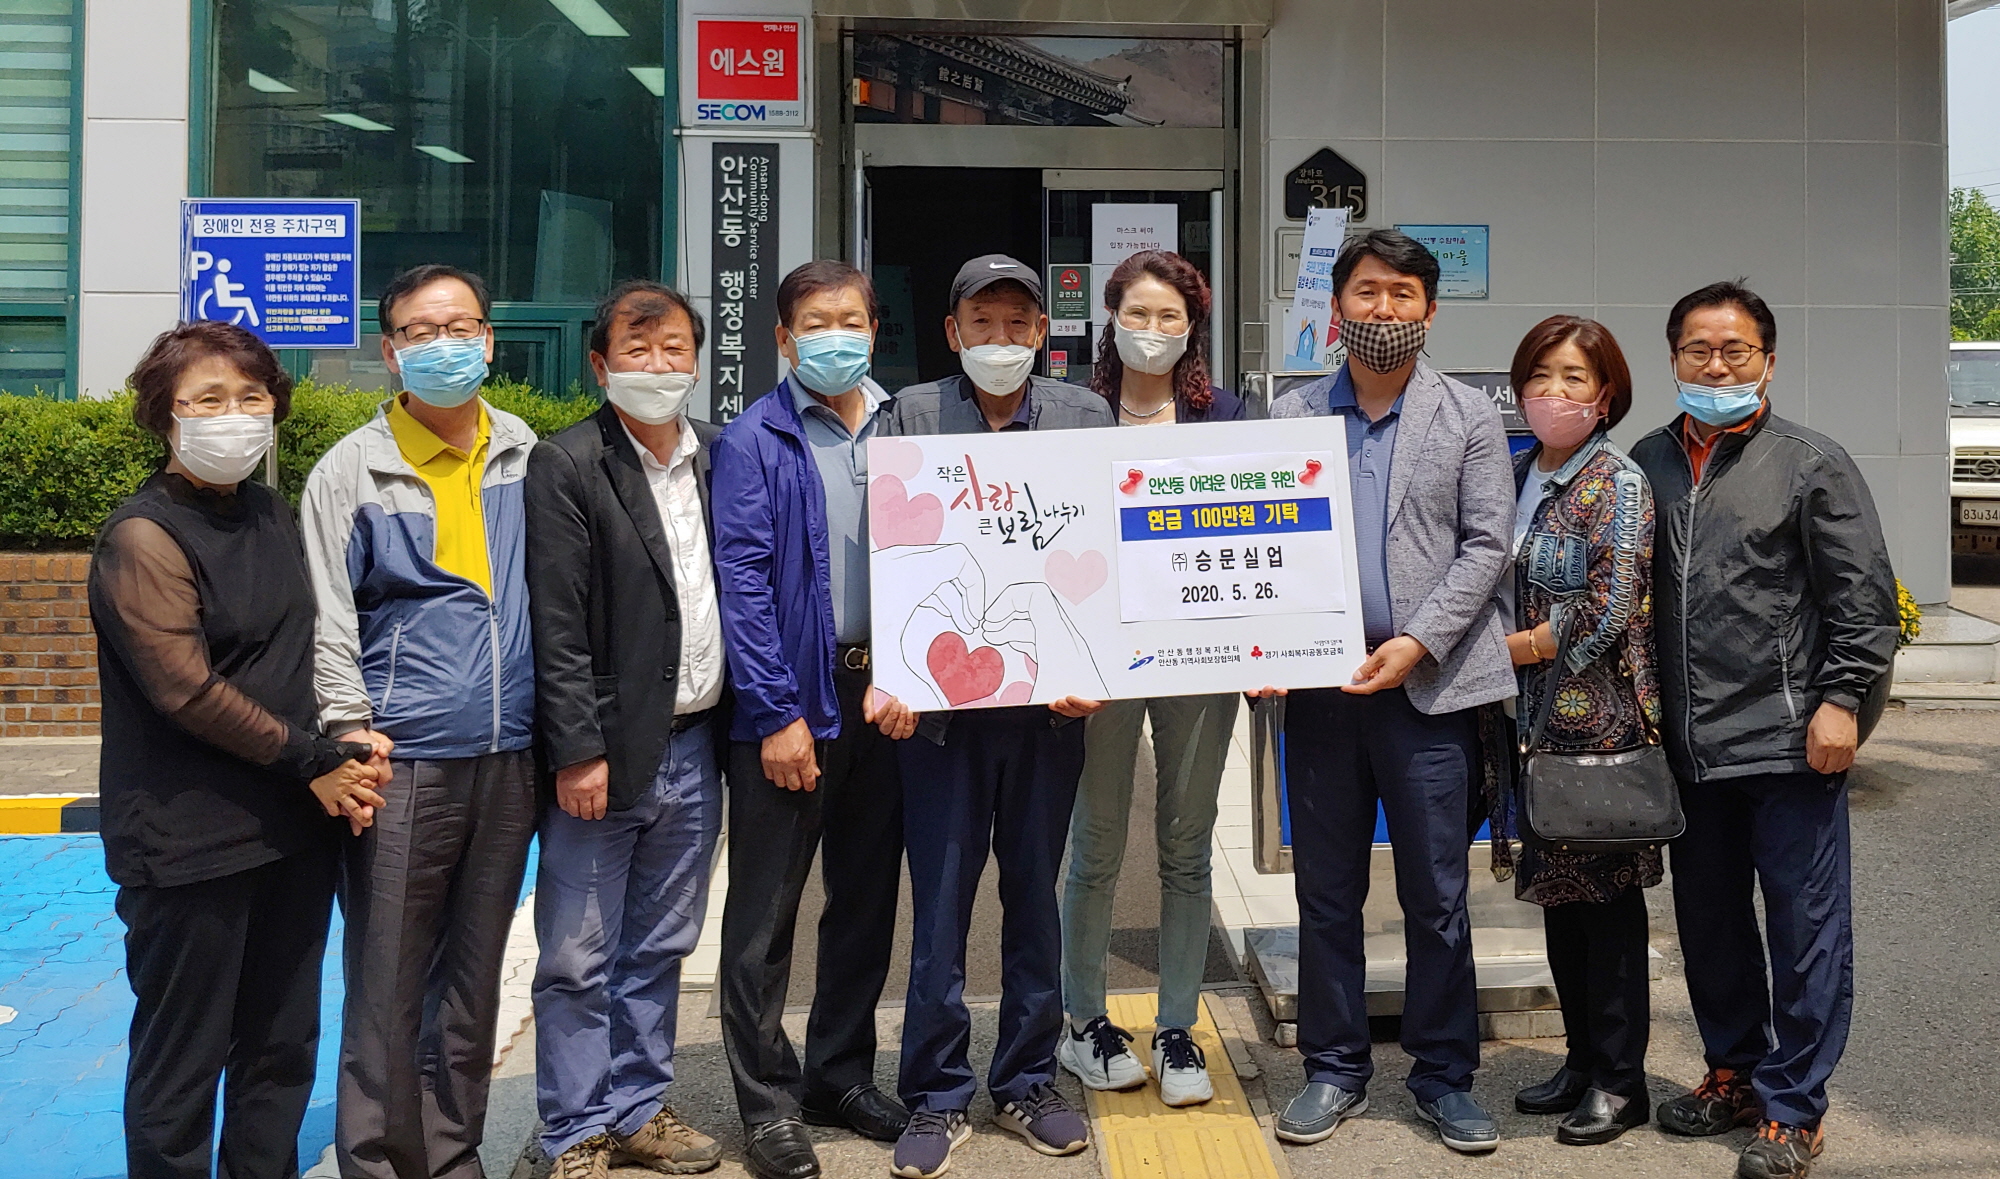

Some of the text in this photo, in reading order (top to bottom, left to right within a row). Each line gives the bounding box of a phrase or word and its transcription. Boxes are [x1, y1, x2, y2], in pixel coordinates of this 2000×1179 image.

[710, 48, 785, 77] 에스원
[698, 104, 766, 121] SECOM
[718, 156, 747, 248] 안산동
[758, 157, 770, 222] Ansan-dong
[1310, 184, 1364, 216] 315
[202, 218, 338, 235] 장애인 전용 주차구역
[748, 156, 760, 300] Community Service Center
[937, 453, 1019, 511] 작은 사랑
[1149, 477, 1184, 495] 안산동
[1189, 474, 1225, 493] 어려운
[1230, 472, 1266, 490] 이웃을
[978, 518, 993, 535] 큰
[1147, 502, 1299, 531] 현금 100만원 기탁
[1181, 581, 1278, 603] 2020. 5. 26.
[1158, 654, 1241, 667] 안산동 지역사회보장협의체
[1264, 646, 1344, 659] 경기 사회복지공동모금회
